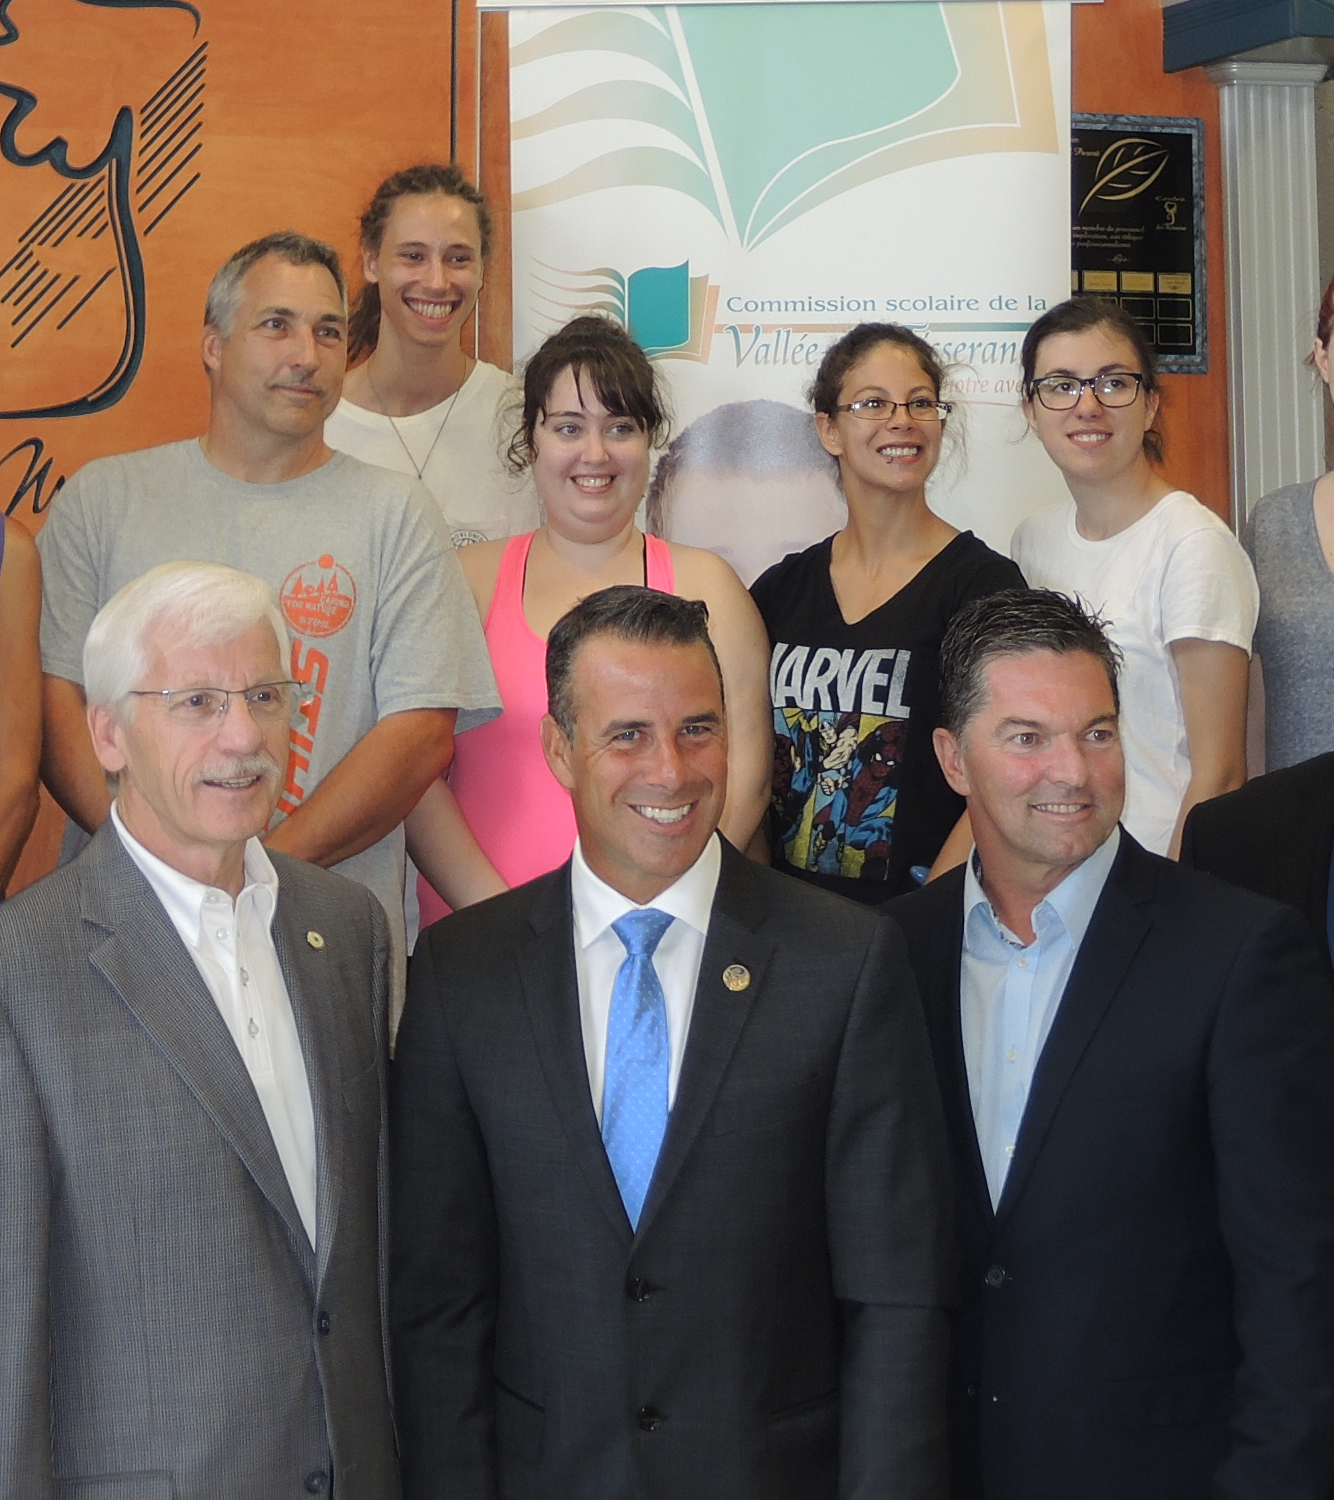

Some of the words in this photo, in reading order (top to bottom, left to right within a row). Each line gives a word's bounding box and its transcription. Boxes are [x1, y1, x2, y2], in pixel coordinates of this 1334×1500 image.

[726, 296, 876, 312] Commission
[885, 295, 979, 311] scolaire
[988, 295, 1018, 311] de
[1027, 295, 1047, 311] la
[994, 379, 1024, 393] ave
